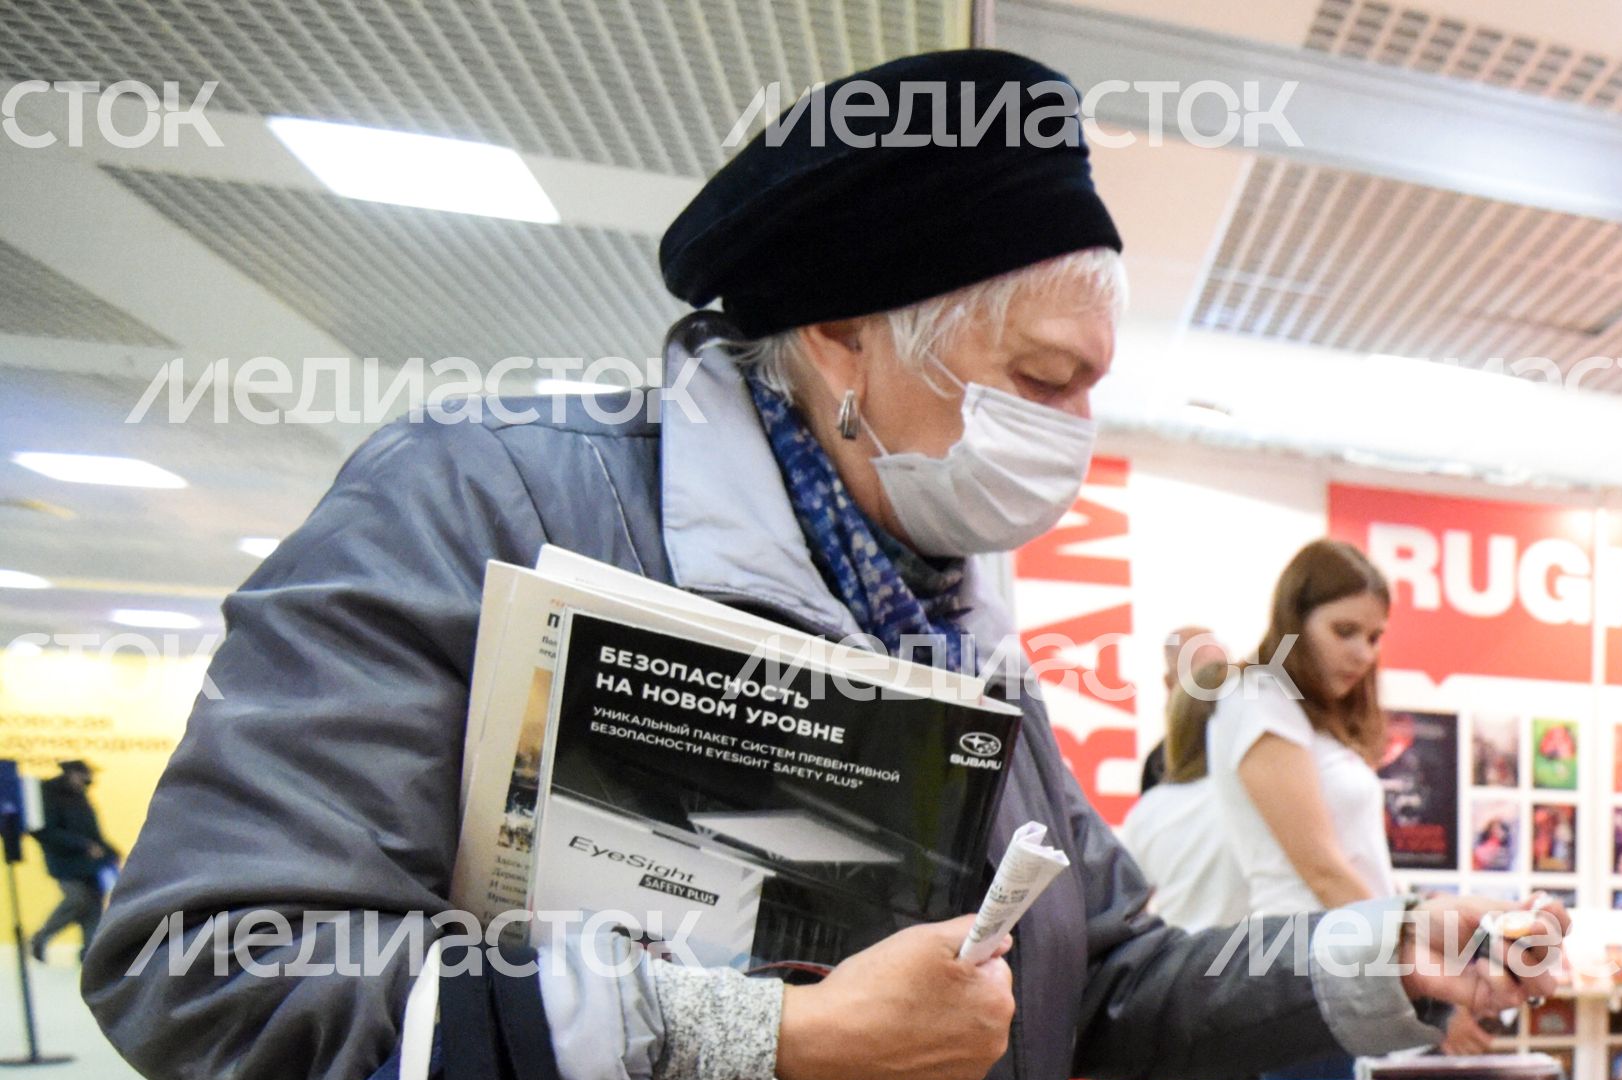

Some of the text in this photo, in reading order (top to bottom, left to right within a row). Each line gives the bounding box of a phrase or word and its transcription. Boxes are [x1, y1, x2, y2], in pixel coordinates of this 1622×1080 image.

[600, 646, 809, 709] БЕЗОПАСНОСТЬ
[595, 672, 845, 744] НА НОВОМ УРОВНЕ
[590, 721, 702, 755] БЕЗОПАСНОСТИ
[705, 747, 770, 770] EYESIGHT
[772, 761, 824, 781] SAFETY
[593, 705, 900, 784] УНИКАЛЬНЫЙ ПАКЕТ СИСТЕМ ПРЕВЕНТИВНОЙ
[949, 753, 1002, 770] SUBARU
[568, 835, 697, 884] EyeSight
[643, 875, 717, 905] SAFETY PLUS
